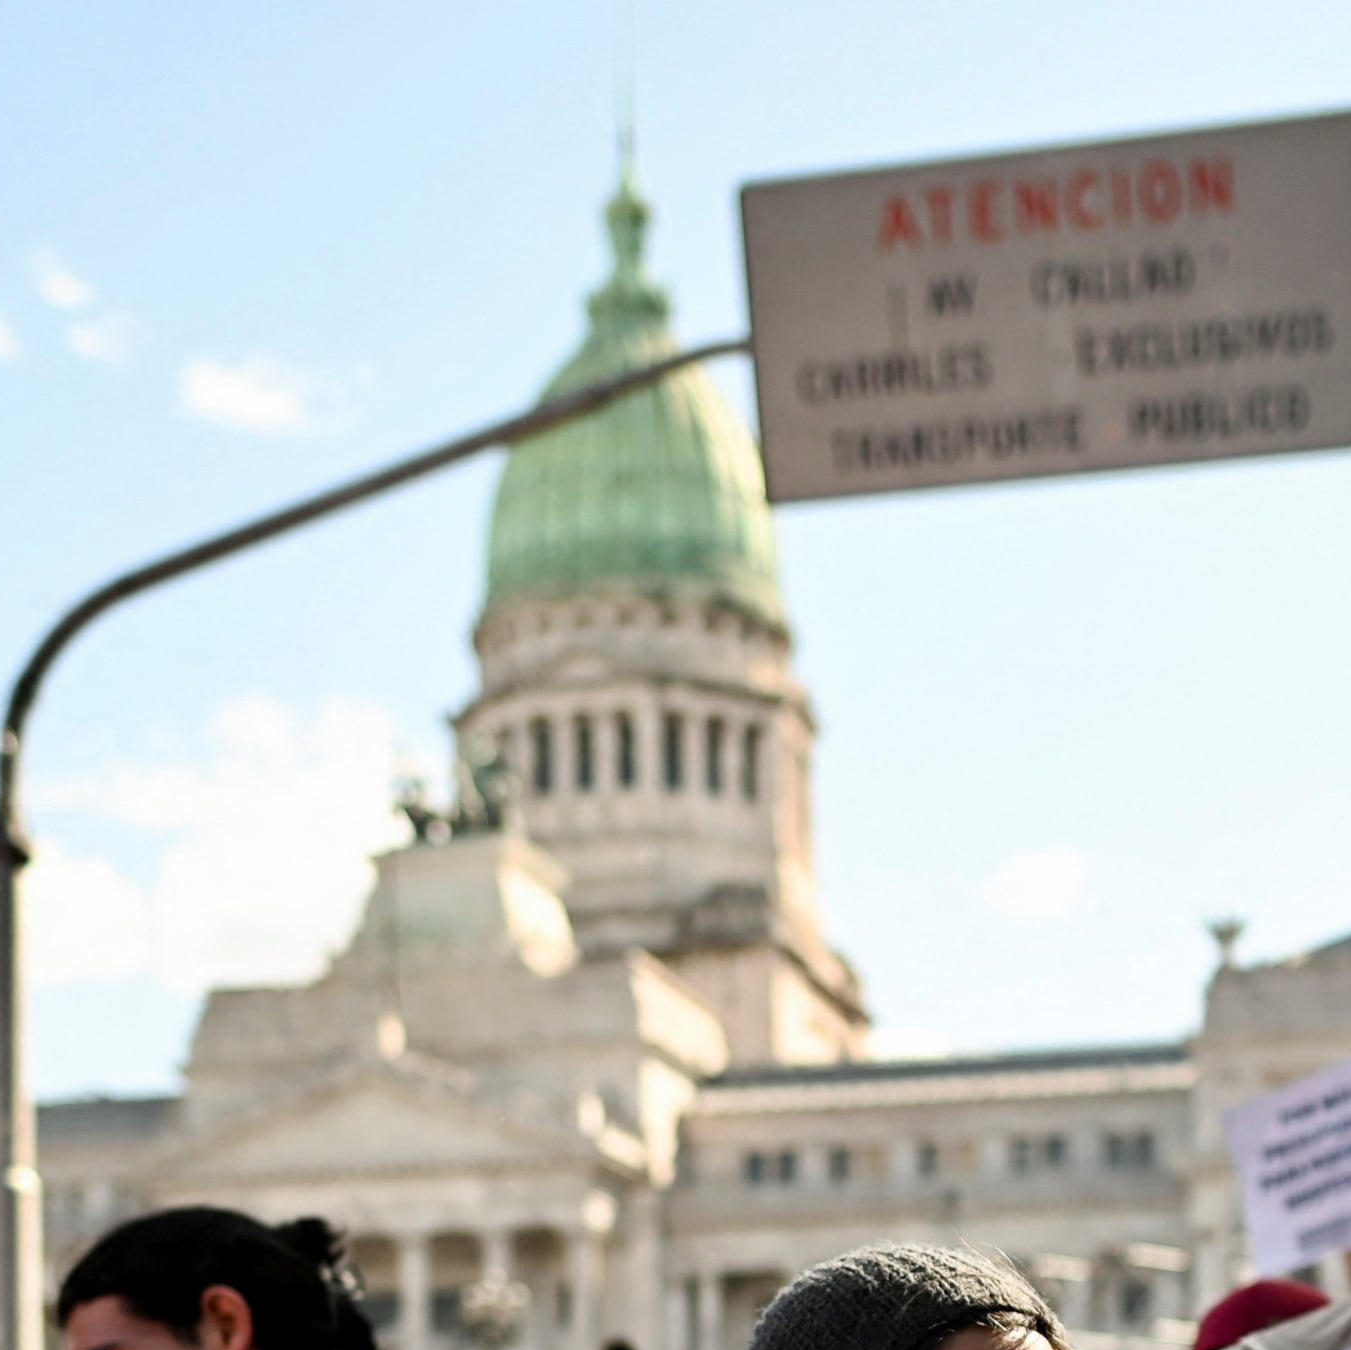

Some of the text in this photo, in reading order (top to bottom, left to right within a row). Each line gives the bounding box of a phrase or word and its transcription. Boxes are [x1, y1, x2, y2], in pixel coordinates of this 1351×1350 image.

[877, 154, 1236, 250] ATENCION
[1073, 303, 1335, 376] EXCLUSIVOS
[832, 403, 1086, 475] TRANSPORTE
